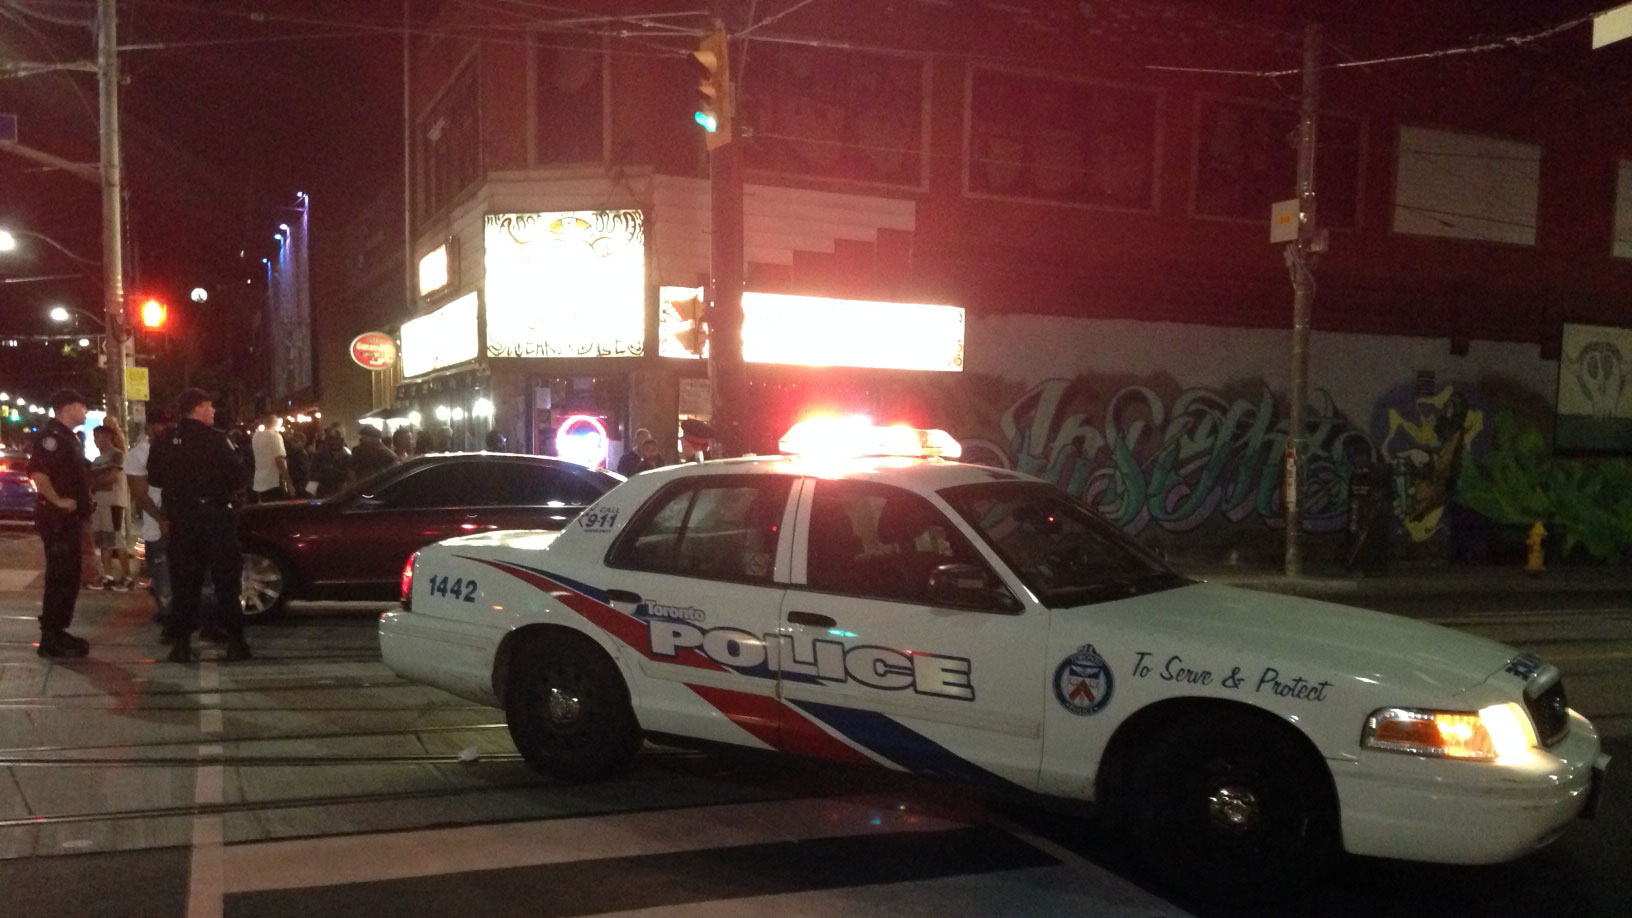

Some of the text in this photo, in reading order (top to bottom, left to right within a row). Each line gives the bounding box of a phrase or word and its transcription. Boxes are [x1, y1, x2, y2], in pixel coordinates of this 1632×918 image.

[429, 574, 478, 603] 1442
[645, 599, 705, 622] Toronto
[648, 620, 975, 701] POLICE
[1132, 651, 1152, 678] To
[1159, 655, 1214, 685] Serve
[1221, 666, 1246, 689] &
[1255, 667, 1336, 702] Protect
